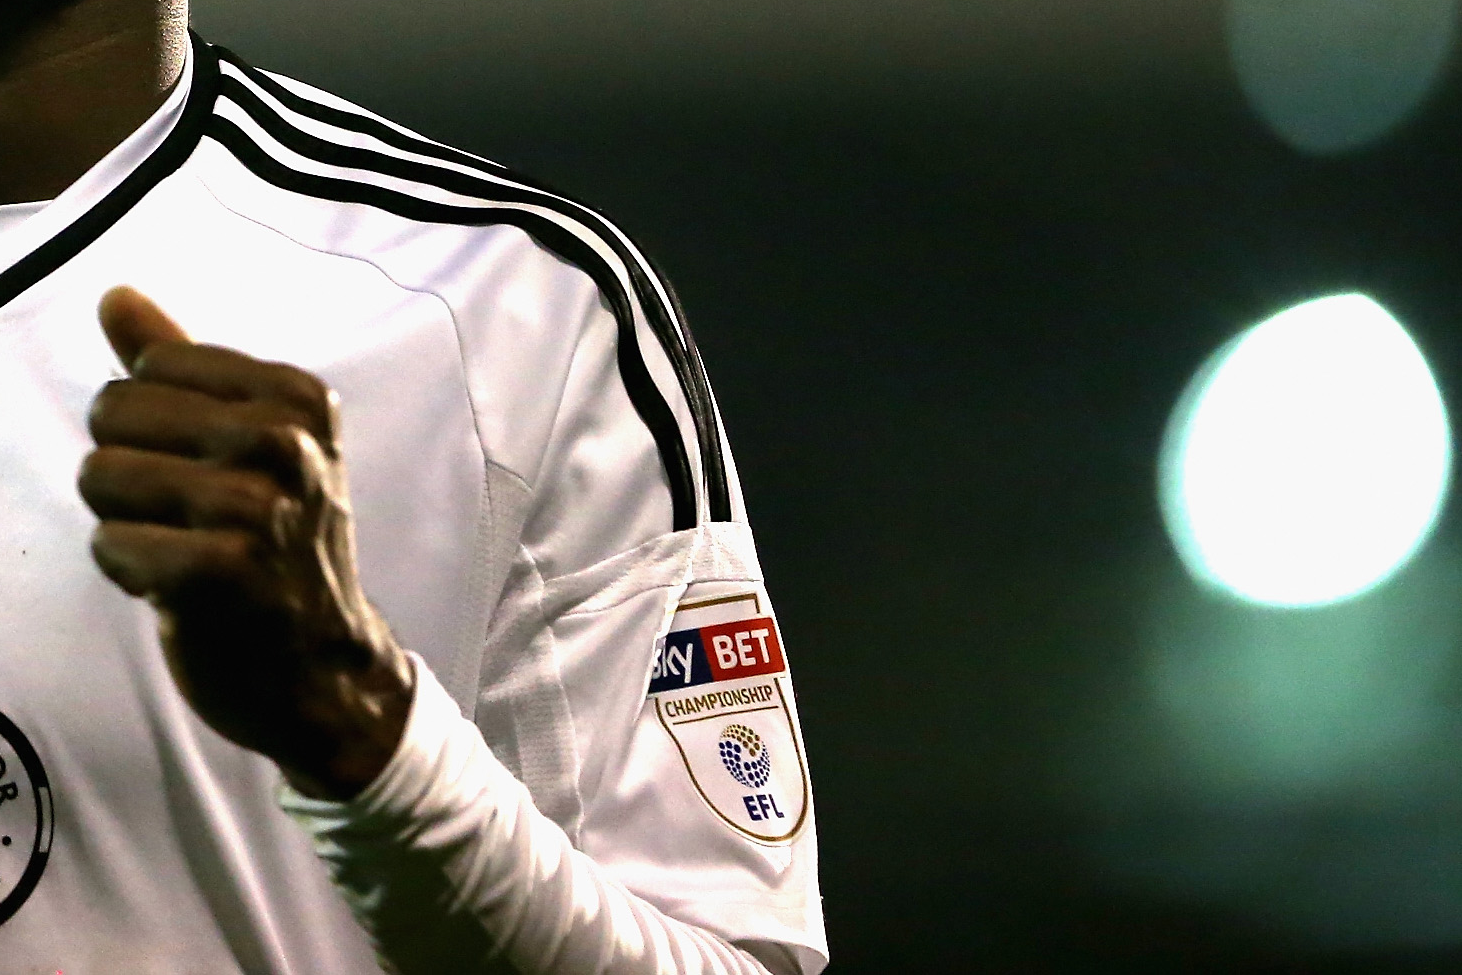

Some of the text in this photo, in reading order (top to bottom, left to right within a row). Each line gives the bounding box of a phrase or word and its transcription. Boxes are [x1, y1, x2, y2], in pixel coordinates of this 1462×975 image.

[712, 628, 770, 670] BET
[665, 685, 773, 717] CHAMPIONSHIP
[743, 793, 785, 821] EFL
